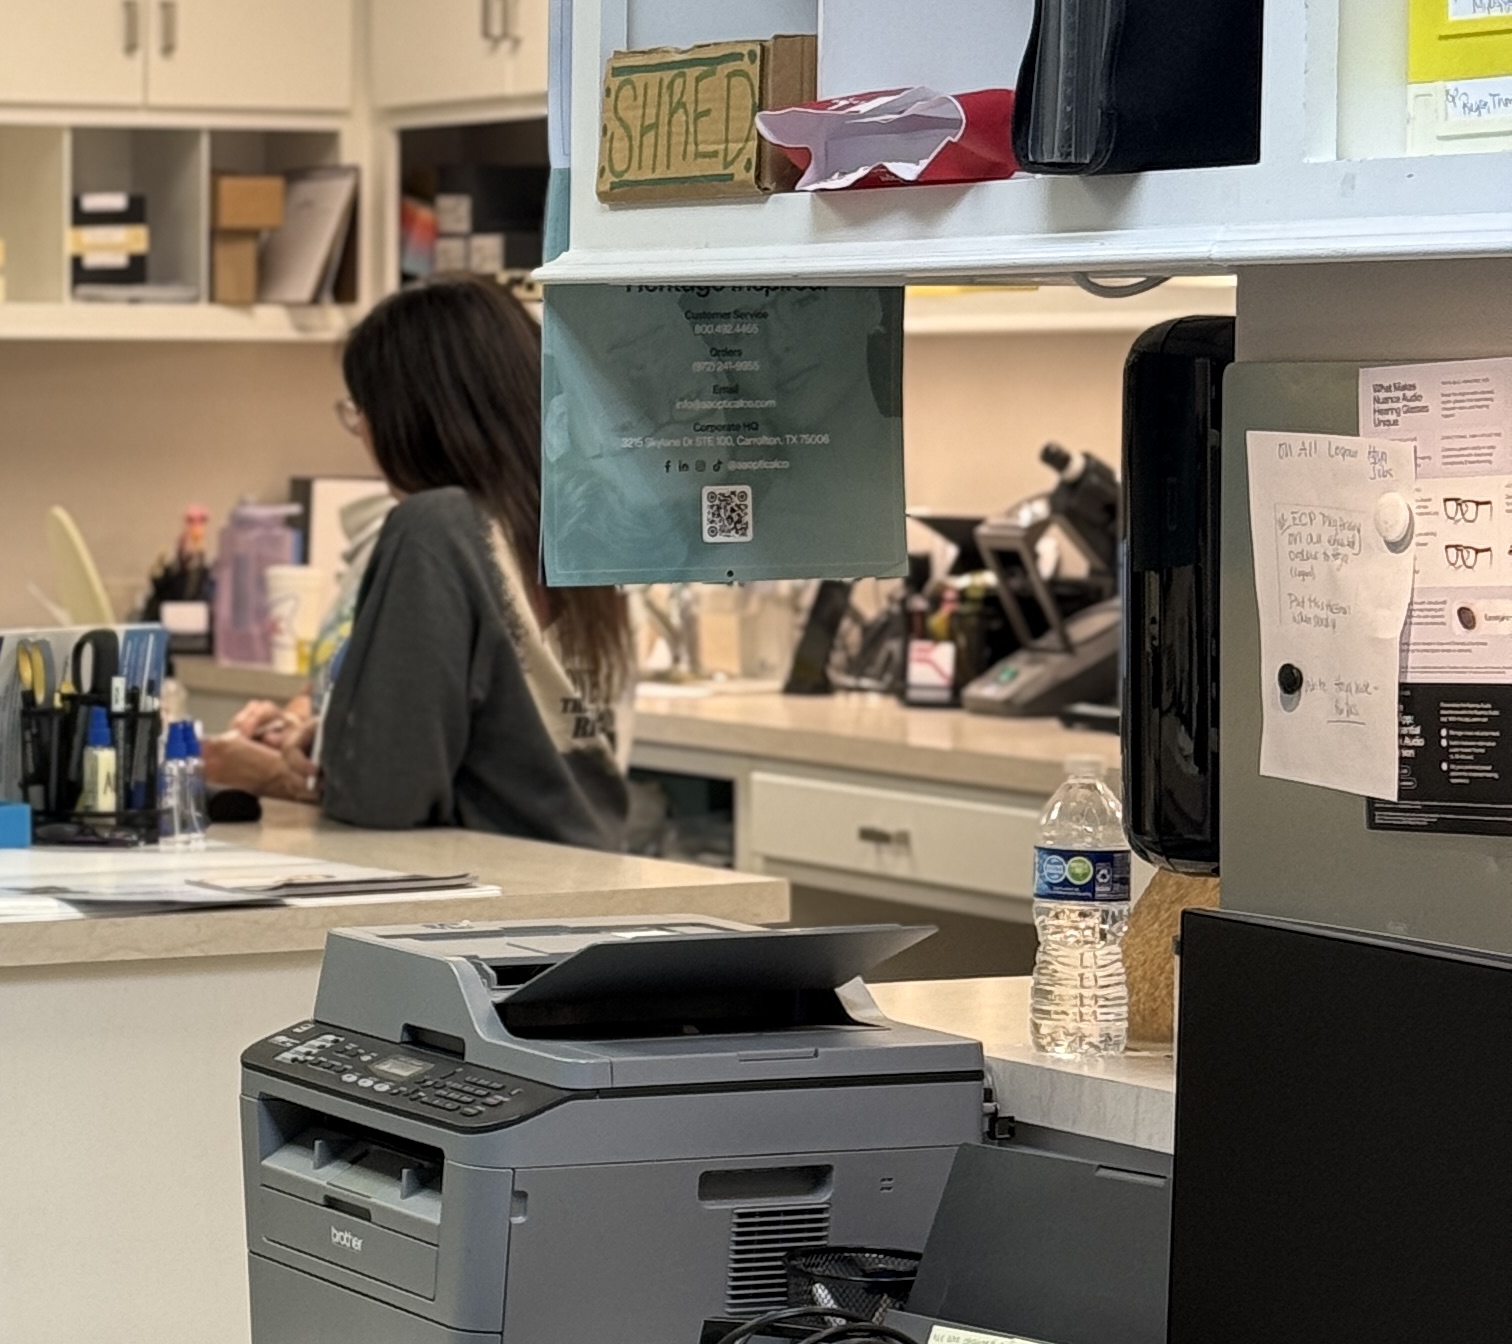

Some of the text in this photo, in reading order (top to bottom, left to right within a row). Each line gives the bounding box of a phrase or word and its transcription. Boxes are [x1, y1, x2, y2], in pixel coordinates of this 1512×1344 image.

[607, 68, 757, 179] SHRED
[684, 309, 769, 321] Customer Service
[709, 347, 743, 358] Orders
[712, 385, 740, 395] Email
[1372, 383, 1392, 393] What
[1373, 392, 1424, 405] Nuance Audio
[1373, 406, 1401, 417] Hearing
[692, 421, 759, 434] Corporate HQ
[621, 437, 643, 449] 3215
[694, 436, 715, 447] STE
[716, 436, 735, 448] 100,
[785, 434, 798, 445] TX
[330, 1225, 364, 1252] brother
